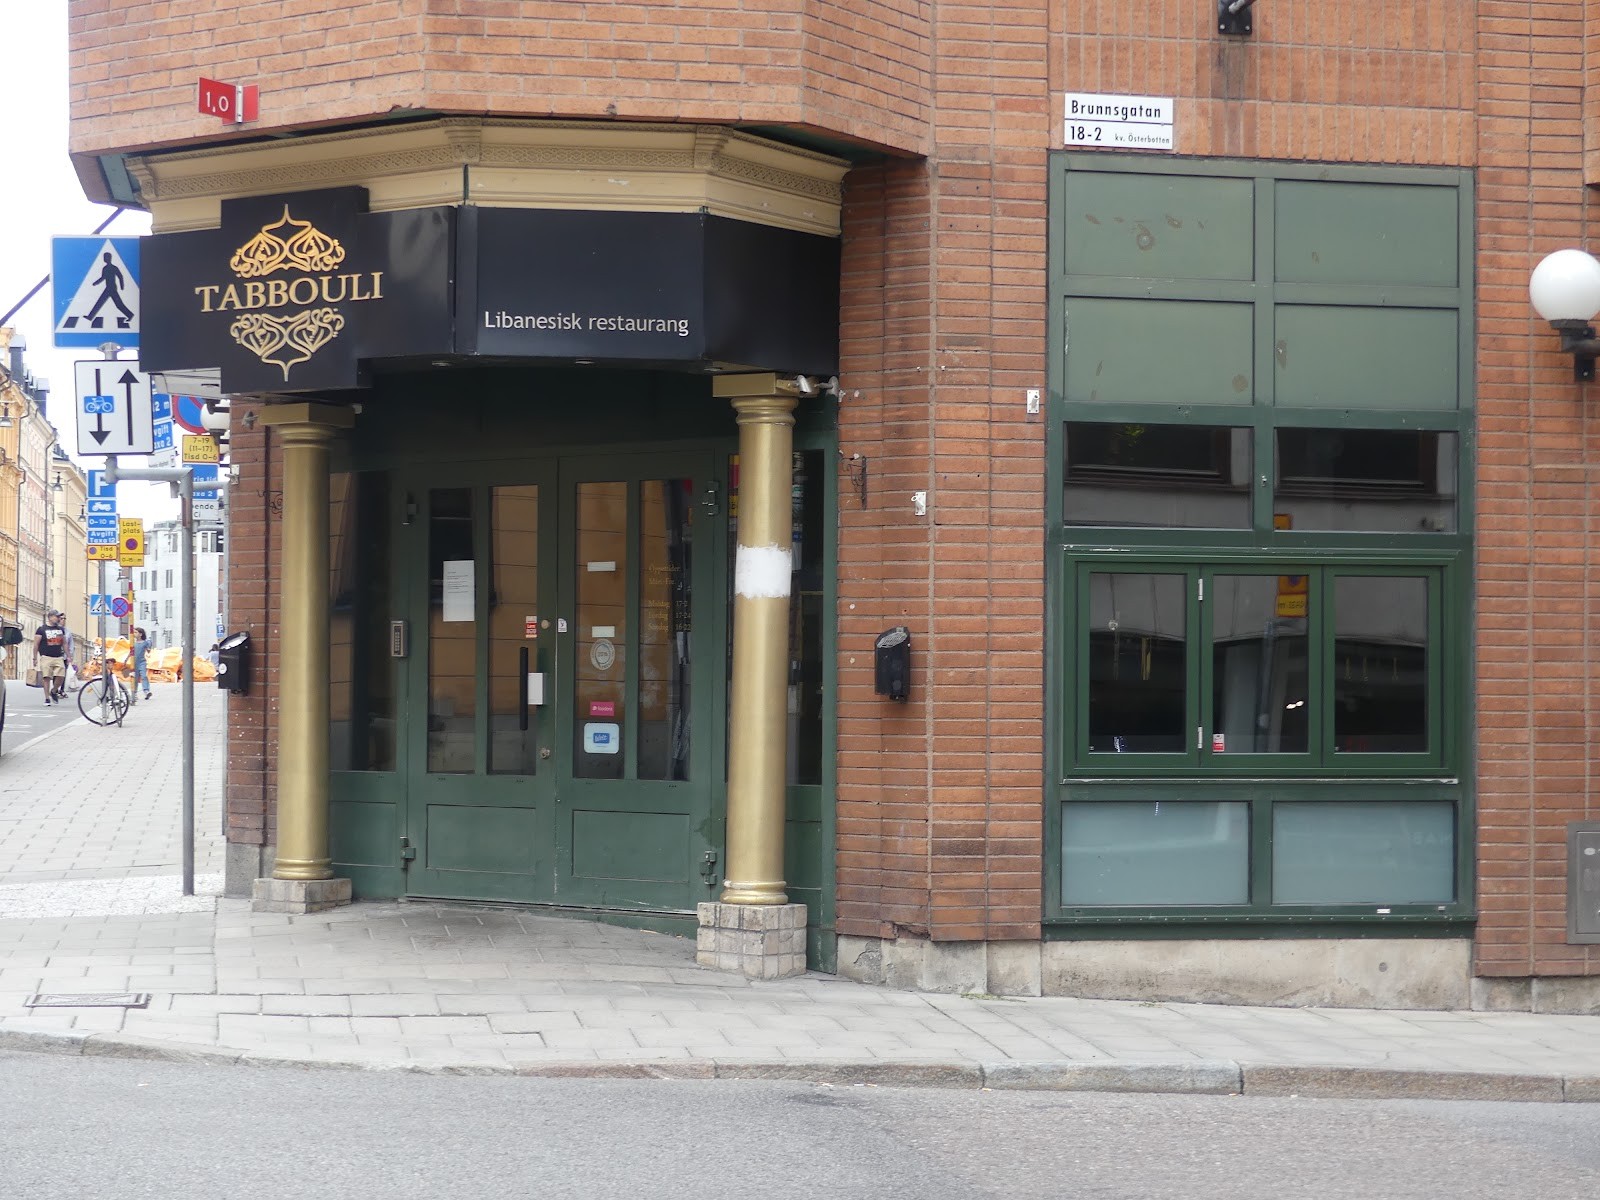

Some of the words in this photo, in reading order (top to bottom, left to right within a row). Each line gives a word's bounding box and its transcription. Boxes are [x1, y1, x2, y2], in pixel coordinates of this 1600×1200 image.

[1071, 100, 1161, 120] Brunnsgatan
[1070, 126, 1102, 141] 18-2
[1114, 134, 1125, 142] kv.
[1128, 133, 1170, 144] Österbotten
[194, 271, 384, 313] TABBOULI
[484, 311, 582, 330] Libanesisk
[588, 314, 689, 337] restaurang
[153, 423, 169, 438] vgift
[166, 436, 171, 446] 2
[189, 445, 213, 453] (11-17)
[90, 530, 114, 538] Avgift
